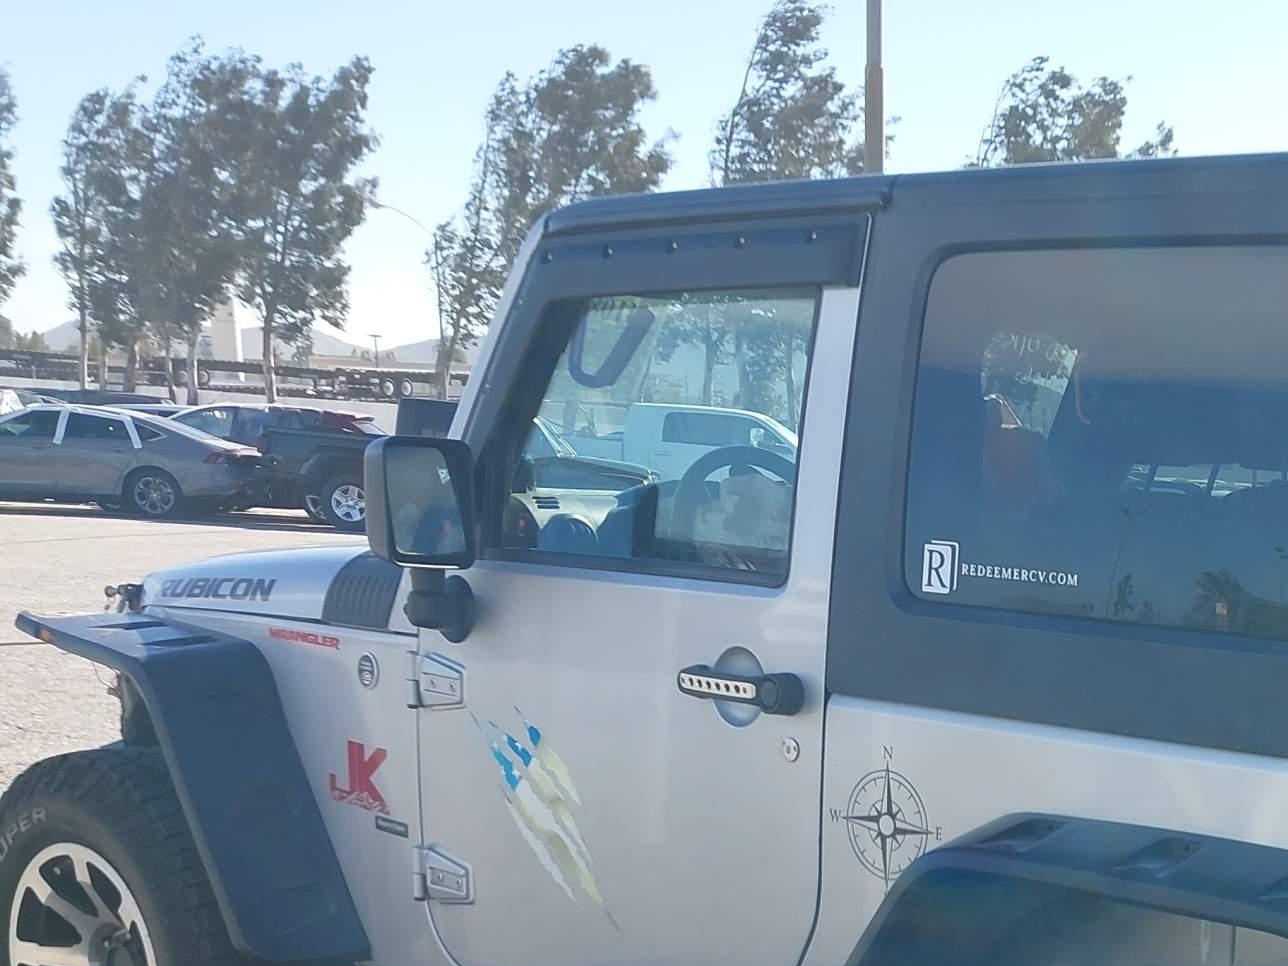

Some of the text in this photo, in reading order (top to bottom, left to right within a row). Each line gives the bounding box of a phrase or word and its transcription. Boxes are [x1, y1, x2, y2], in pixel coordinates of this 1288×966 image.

[961, 562, 1079, 587] REDEEMERCV.COM
[161, 576, 277, 602] RUBICON
[267, 627, 341, 651] WRANGLER
[882, 745, 893, 760] N
[829, 808, 842, 823] W
[935, 826, 943, 841] E
